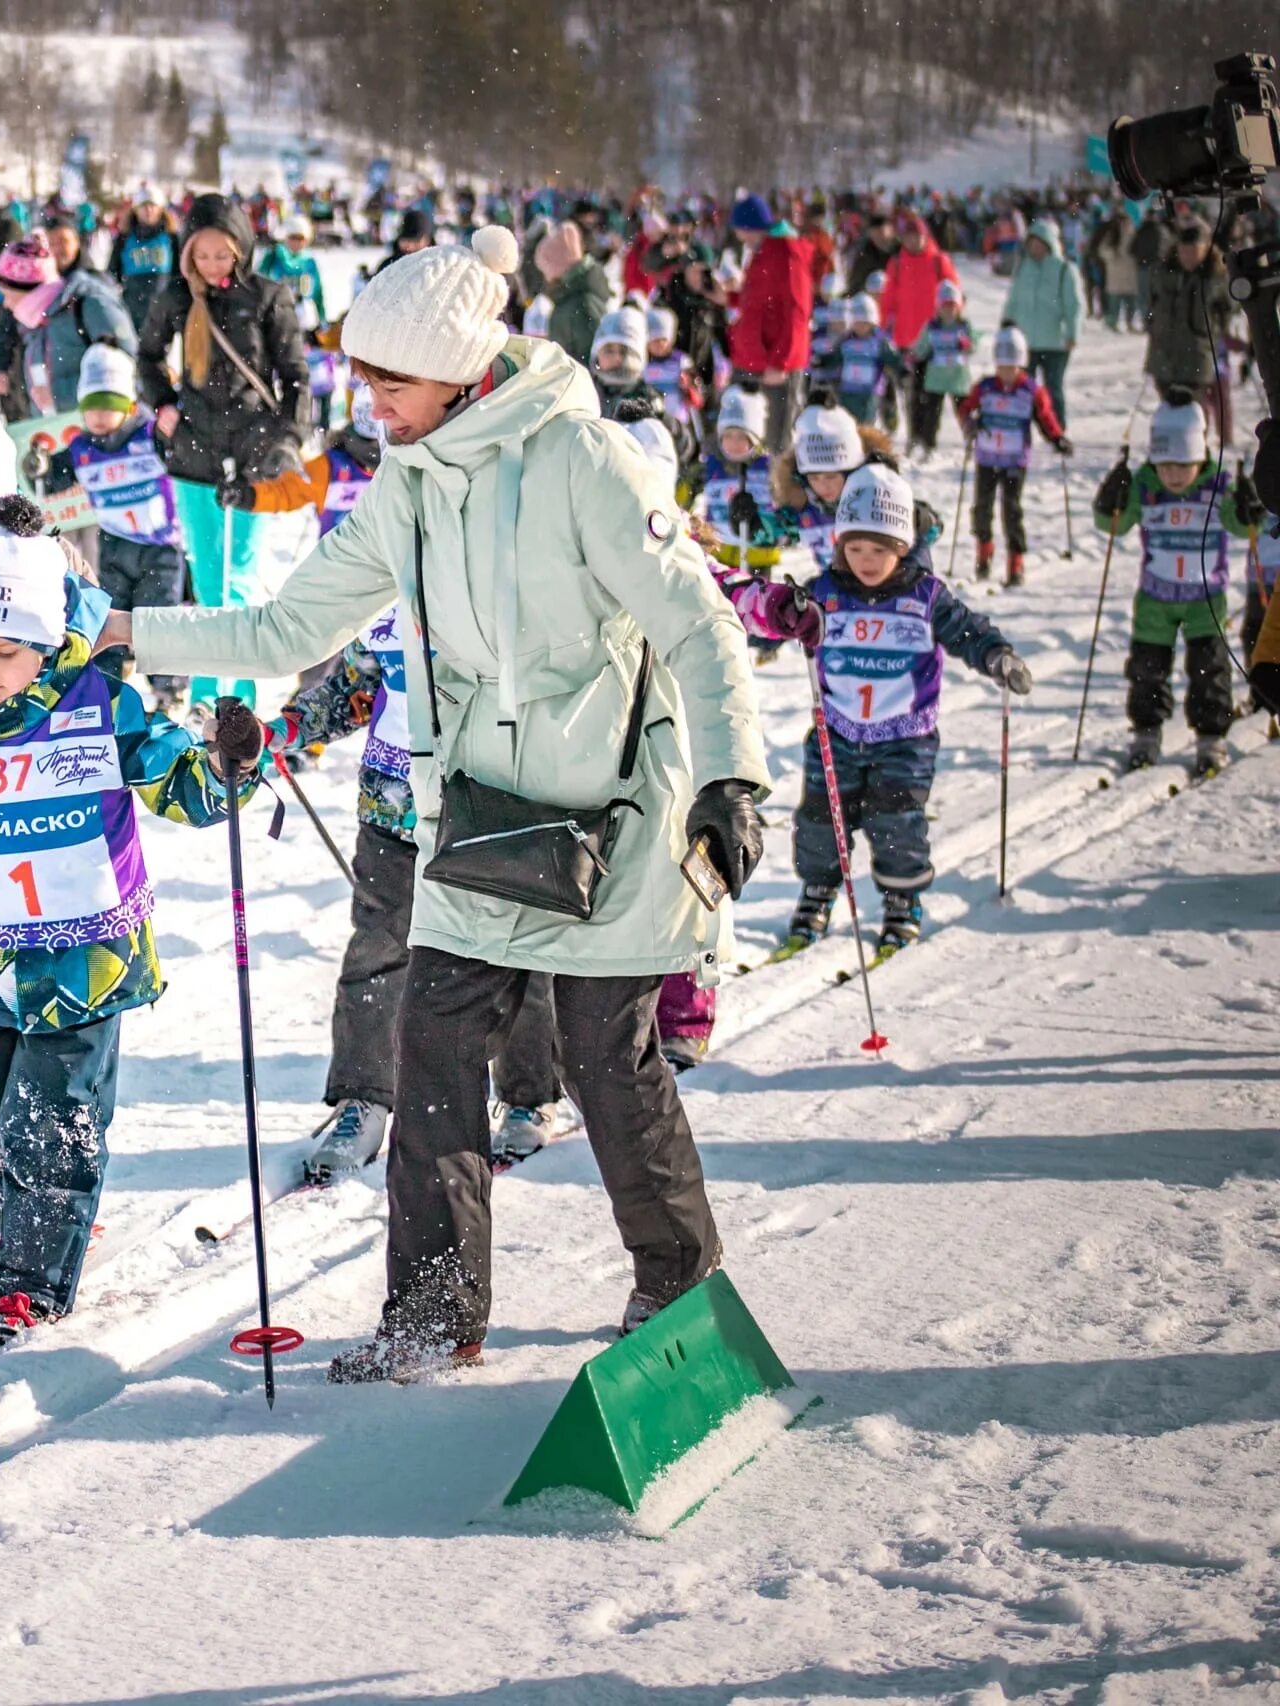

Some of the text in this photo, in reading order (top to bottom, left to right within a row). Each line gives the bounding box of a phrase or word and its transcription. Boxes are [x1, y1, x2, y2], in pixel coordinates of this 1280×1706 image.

[1171, 508, 1193, 526] 87
[1176, 556, 1184, 577] 1
[855, 619, 884, 641] 87
[857, 684, 872, 719] 1
[36, 744, 114, 776] Праздник
[7, 859, 43, 917] 1
